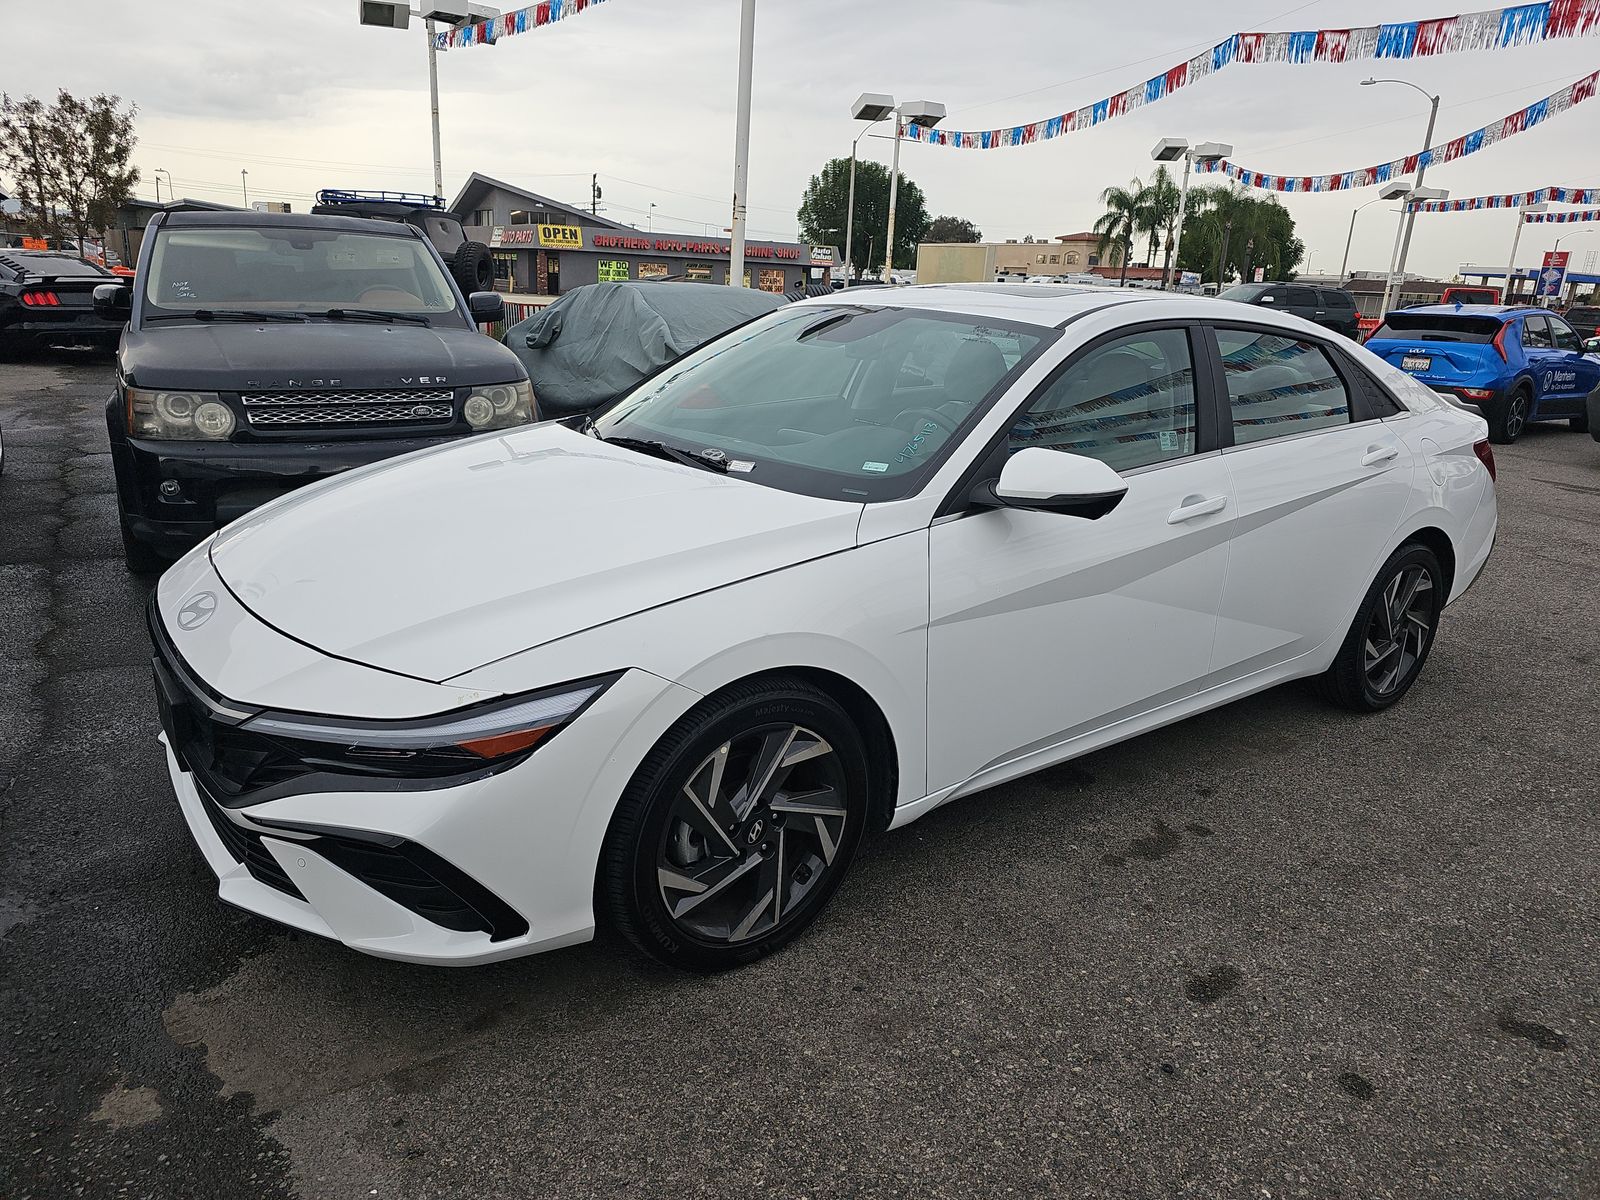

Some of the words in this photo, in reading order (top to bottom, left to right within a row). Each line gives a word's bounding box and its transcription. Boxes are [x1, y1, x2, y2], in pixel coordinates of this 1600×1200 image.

[501, 230, 515, 243] AUTO
[515, 230, 533, 243] PARTS
[542, 227, 578, 239] OPEN
[594, 235, 651, 250] BROTHERS
[655, 240, 682, 251] AUTO
[686, 241, 720, 254] PARTS
[777, 247, 801, 259] SHOP
[812, 246, 831, 254] Auto
[600, 260, 612, 268] WE
[1553, 370, 1576, 381] Manheim
[247, 379, 342, 388] RANGE
